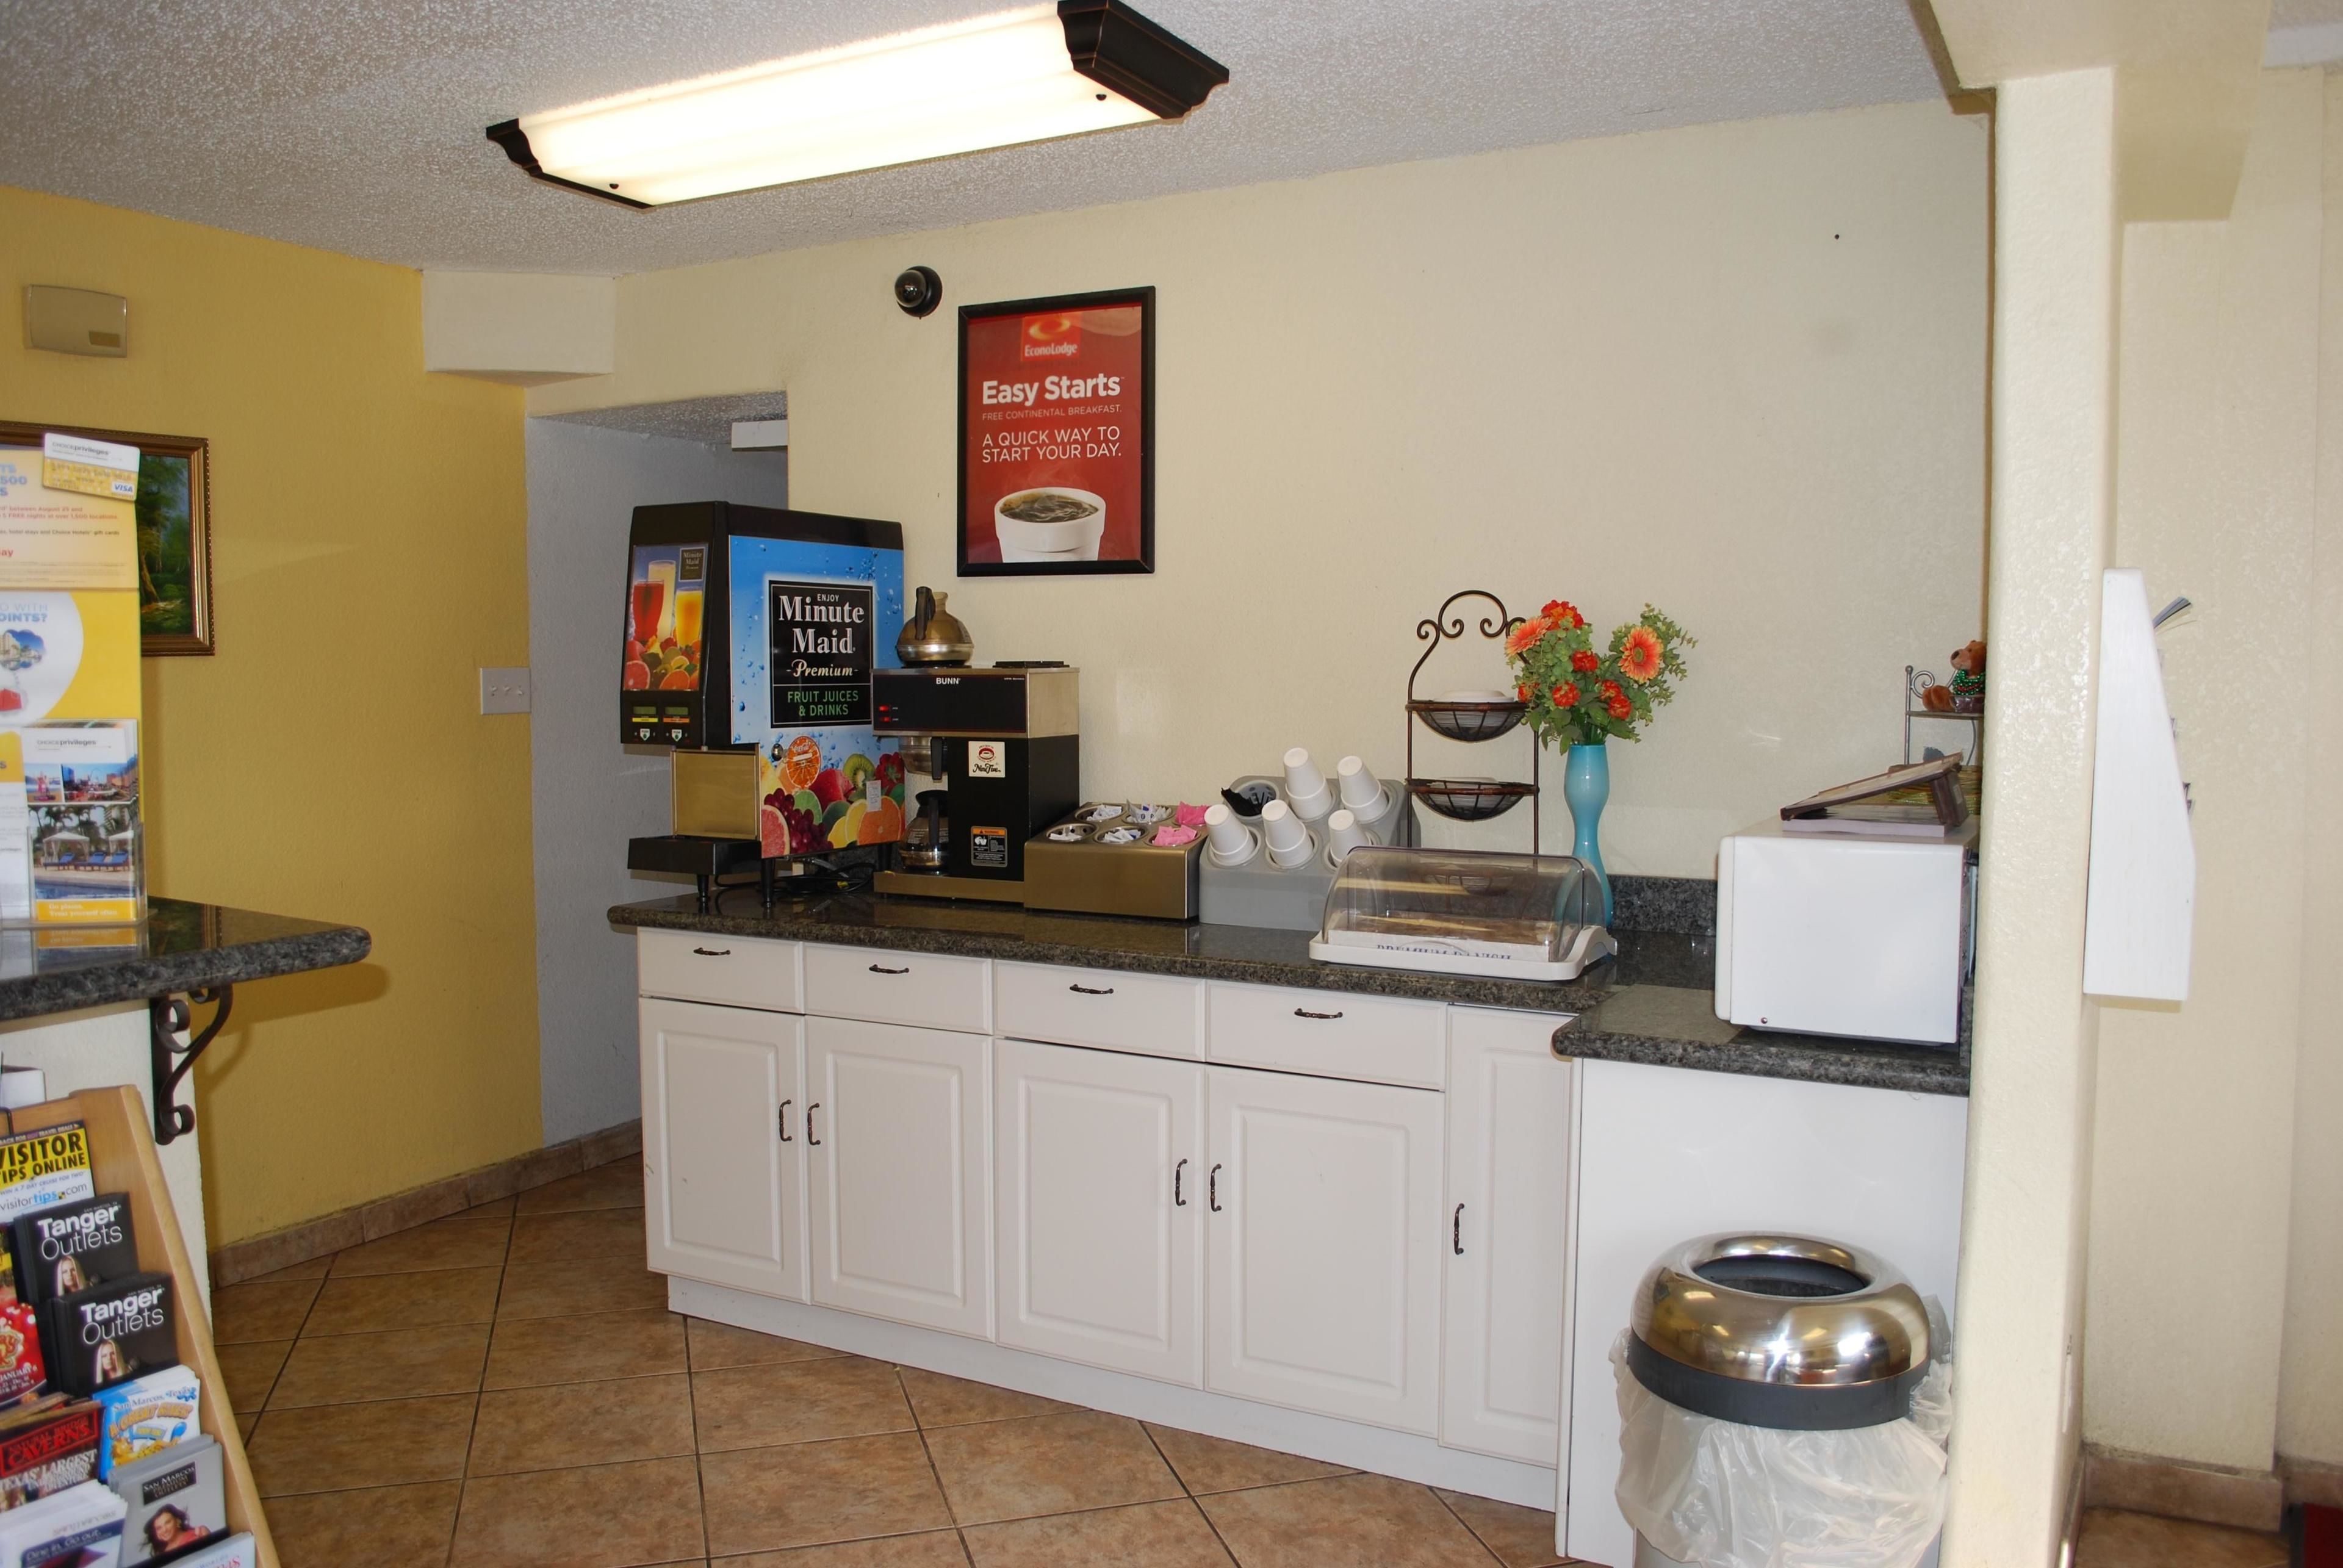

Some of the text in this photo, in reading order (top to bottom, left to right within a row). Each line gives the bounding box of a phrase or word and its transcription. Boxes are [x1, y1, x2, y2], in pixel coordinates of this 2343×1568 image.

[1024, 342, 1078, 357] EconoLodge
[982, 373, 1120, 406] Easy Starts
[982, 404, 1121, 421] FREE CONTINENTAL BREAKFAST.
[982, 426, 1120, 447] A QUICK WAY TO
[982, 442, 1121, 463] START YOUR DAY.
[114, 484, 133, 493] VISA
[15, 602, 48, 611] WITH
[779, 595, 865, 624] Minute
[791, 627, 853, 654] Maid
[791, 659, 854, 677] Premium
[787, 690, 858, 703] FRUIT JUICES
[798, 704, 849, 716] & DRINKS
[0, 1152, 86, 1184] IPS ONLINE
[38, 1205, 120, 1238] Tanger
[41, 1225, 123, 1261] Outlets
[81, 1287, 164, 1323] Tanger
[83, 1307, 164, 1345] Outlets
[9, 1424, 90, 1467] CAVERNS
